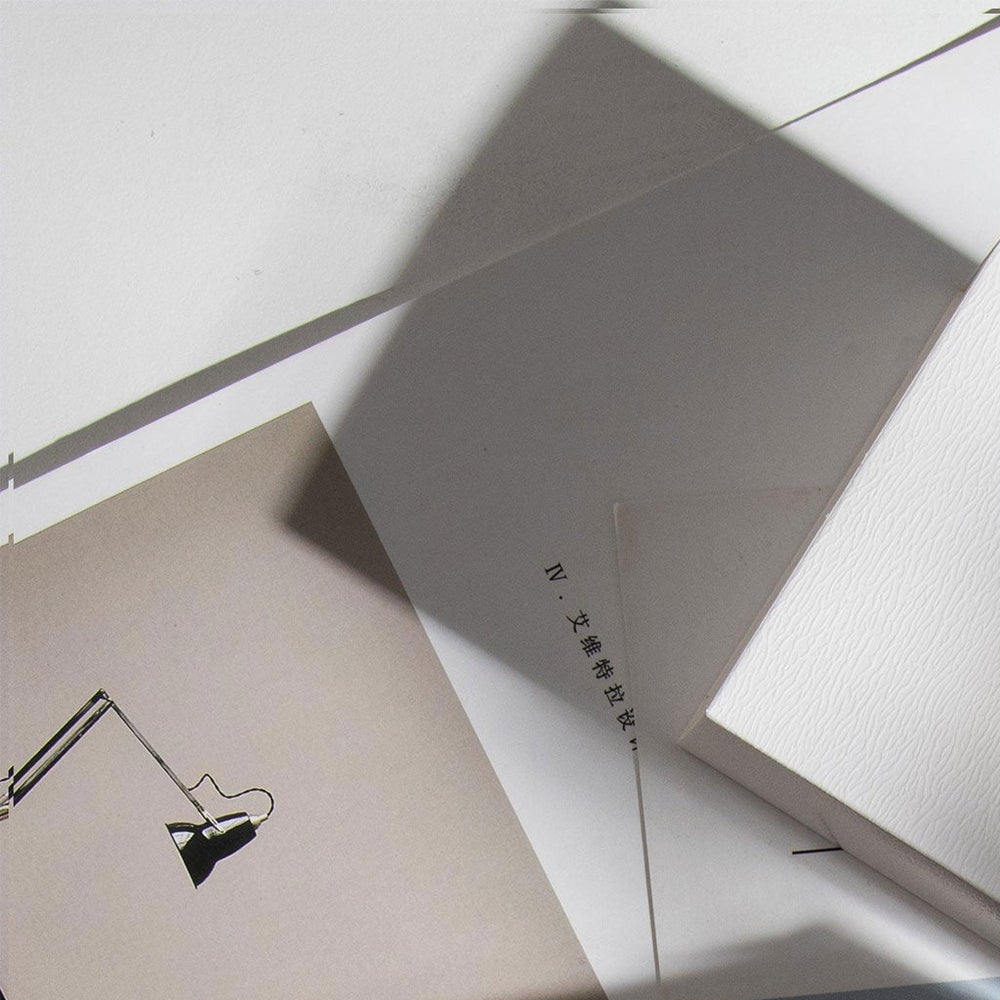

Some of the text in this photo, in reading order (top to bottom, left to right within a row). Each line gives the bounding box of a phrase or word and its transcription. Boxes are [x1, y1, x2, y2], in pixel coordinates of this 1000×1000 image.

[566, 609, 638, 752] 艾维特拉设
